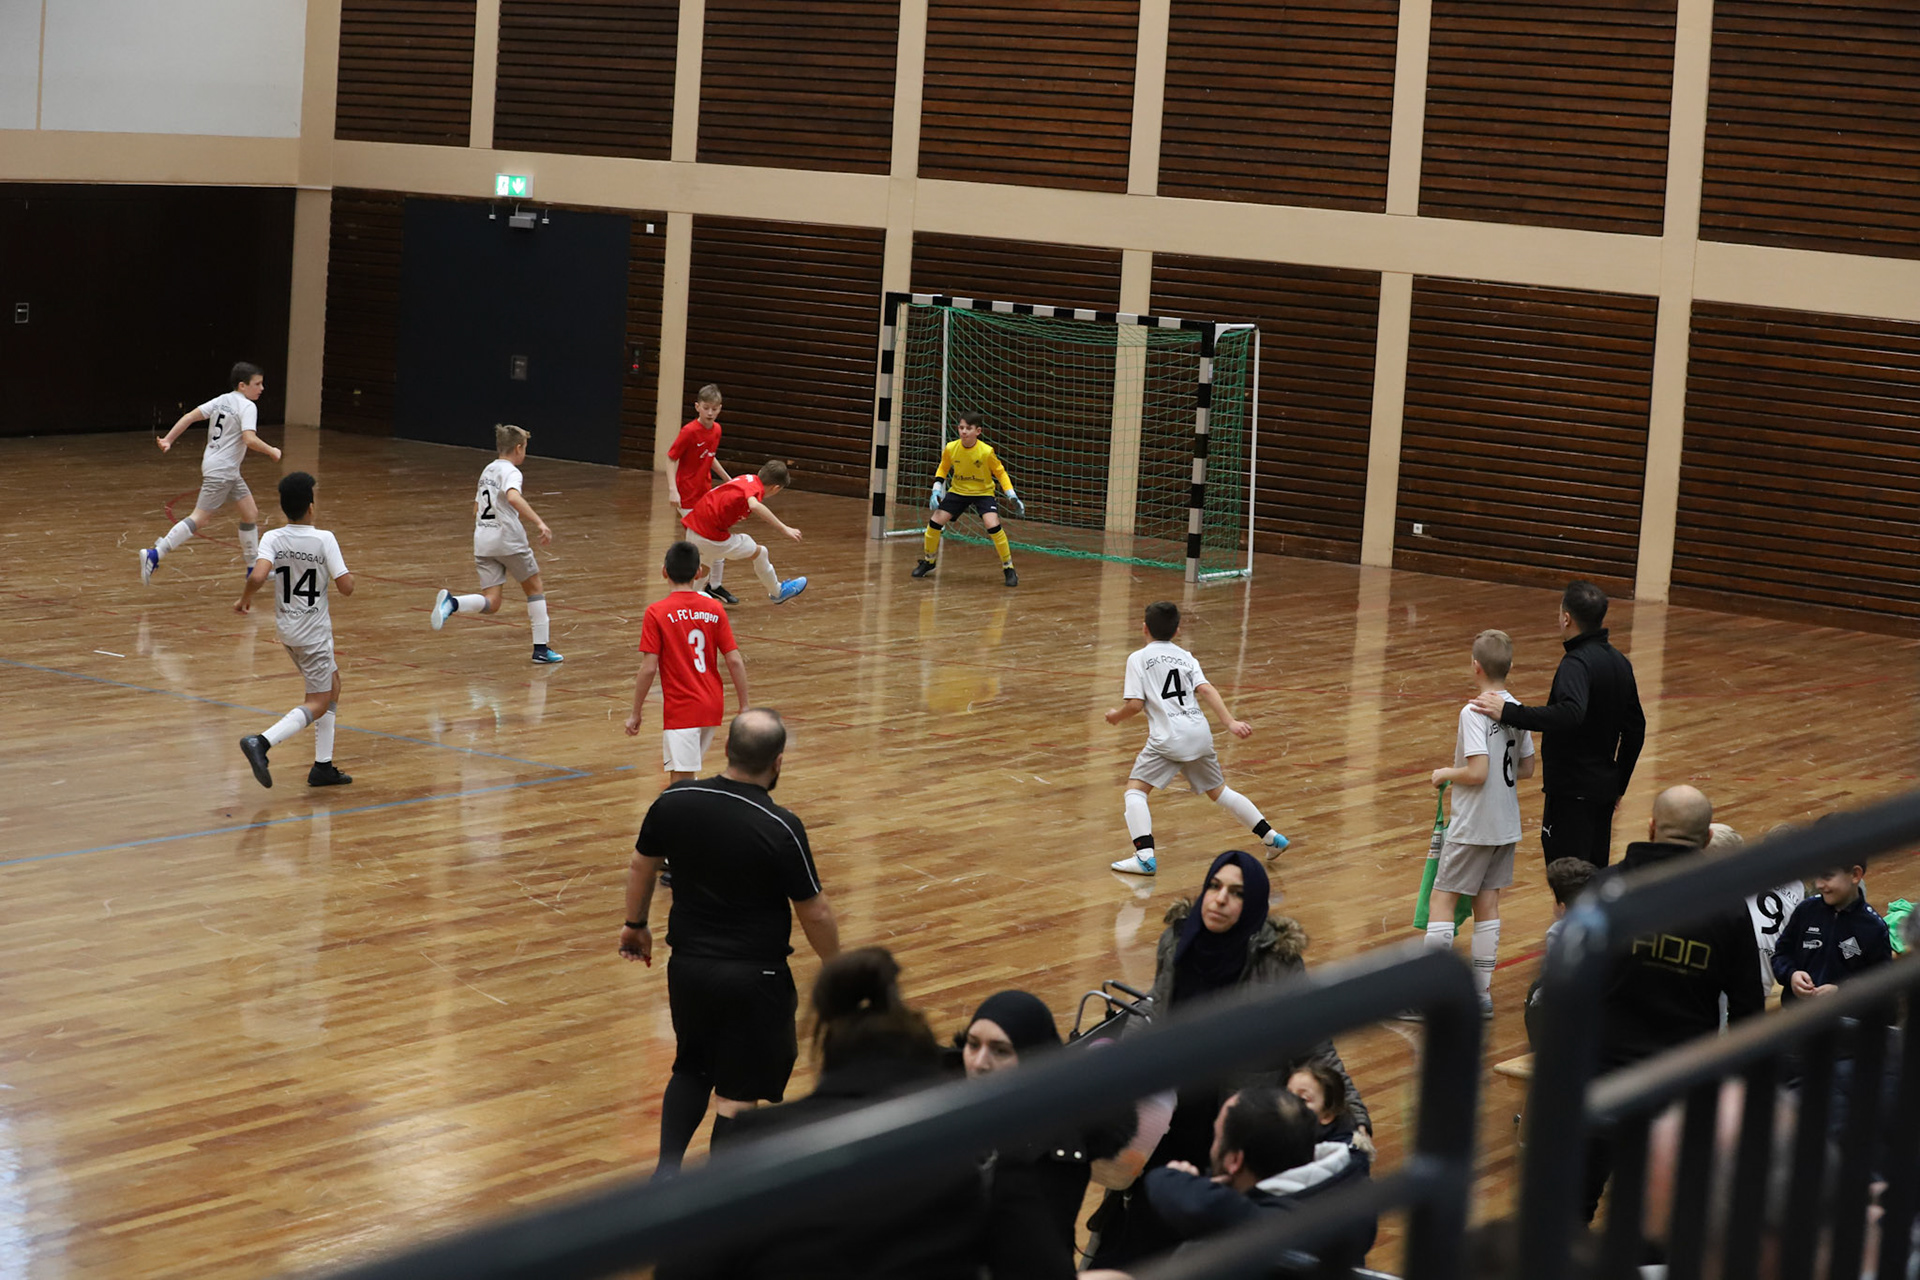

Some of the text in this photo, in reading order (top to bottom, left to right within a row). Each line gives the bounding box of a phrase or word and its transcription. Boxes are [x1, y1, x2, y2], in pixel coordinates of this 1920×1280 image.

[212, 413, 225, 441] 5
[481, 489, 496, 520] 2
[289, 550, 326, 565] RODGAU
[275, 565, 321, 607] 14
[667, 608, 719, 624] 1. FC Langen
[687, 628, 707, 674] 3
[1145, 656, 1160, 671] JSK
[1160, 668, 1187, 707] 4
[1502, 739, 1516, 788] 6
[1756, 891, 1785, 935] 9
